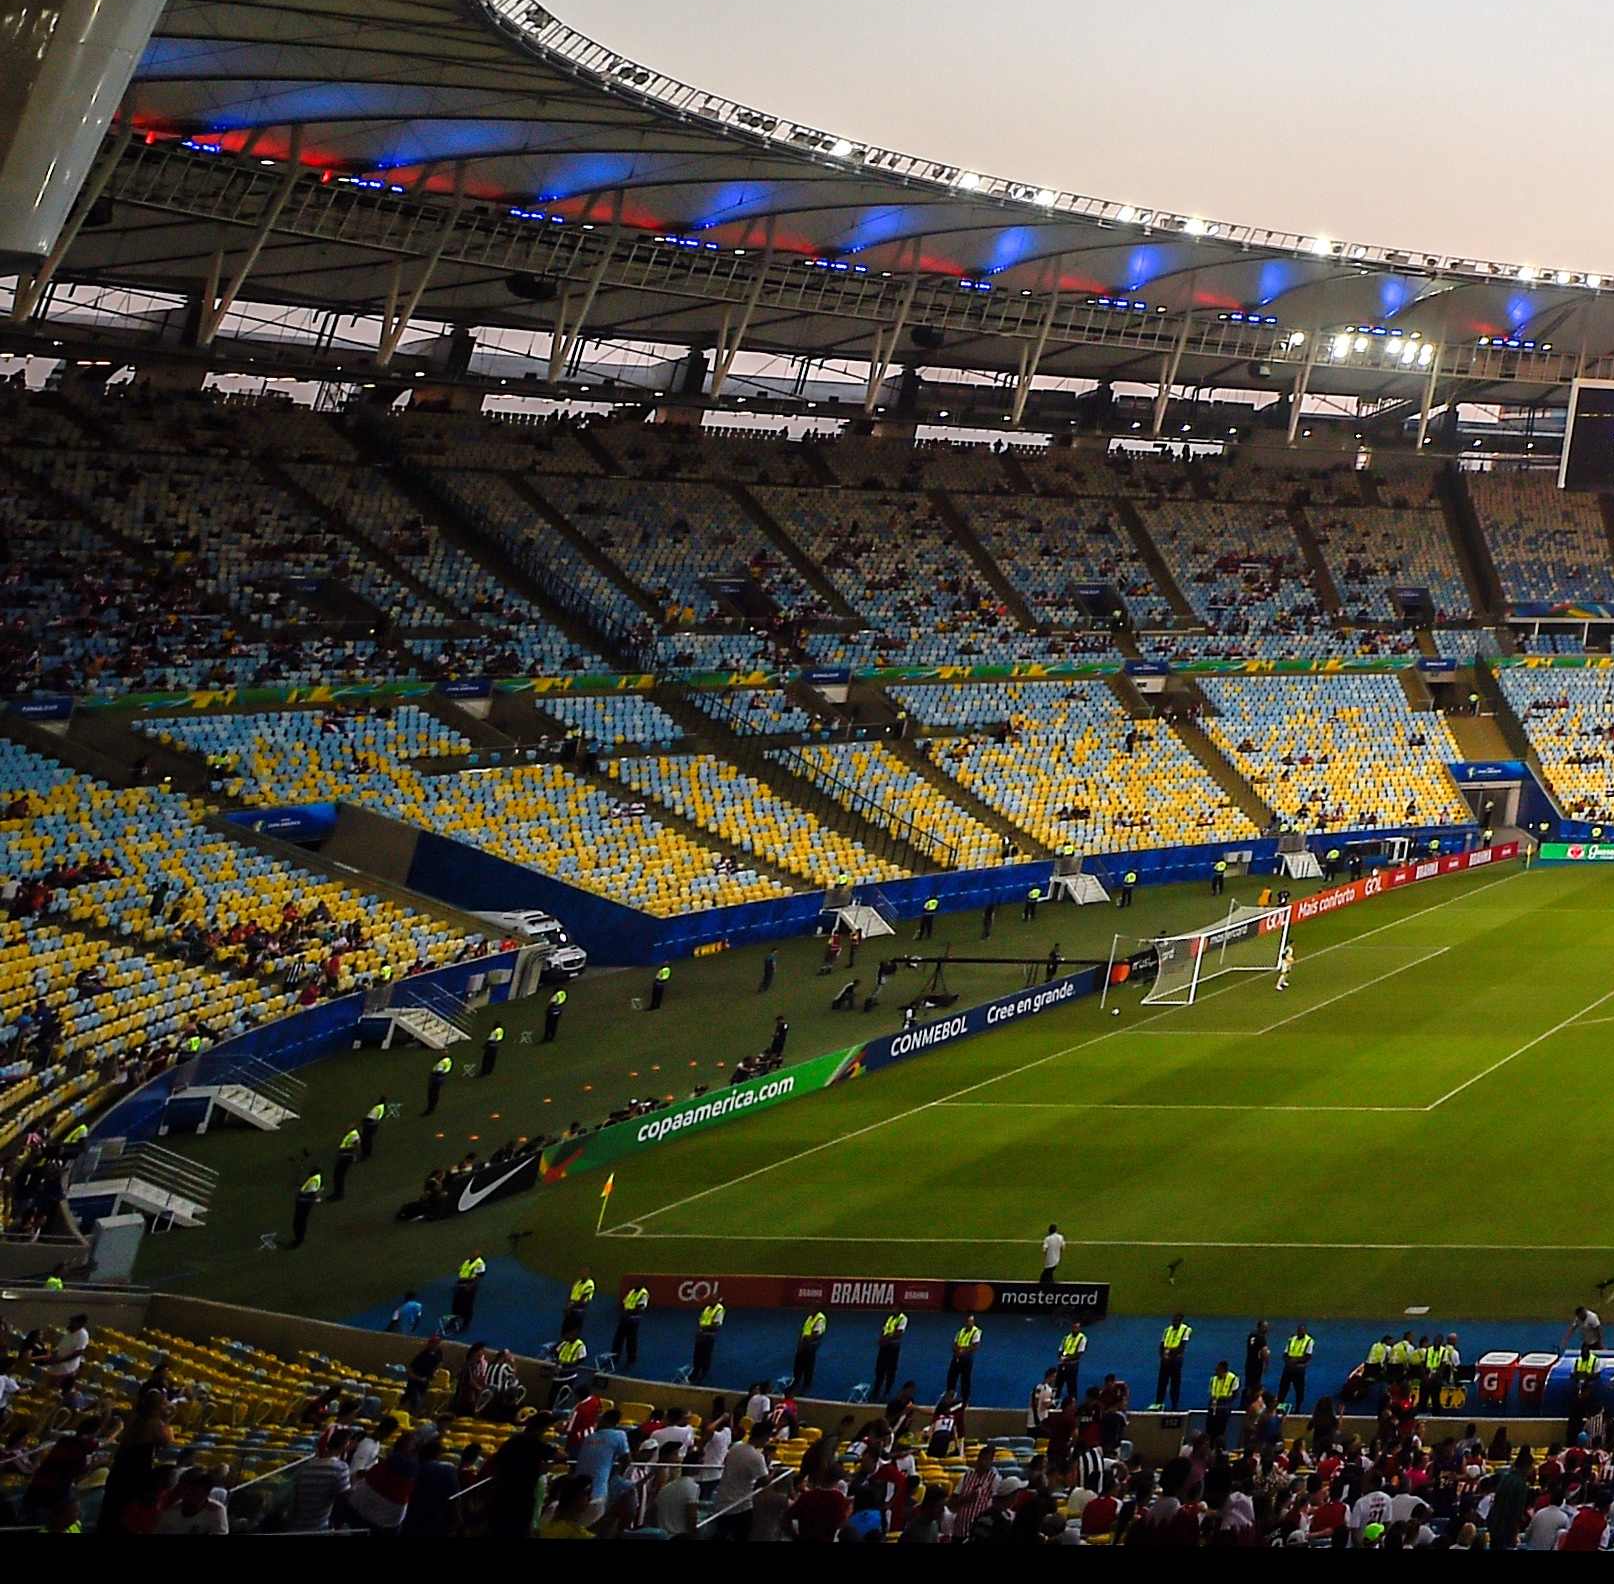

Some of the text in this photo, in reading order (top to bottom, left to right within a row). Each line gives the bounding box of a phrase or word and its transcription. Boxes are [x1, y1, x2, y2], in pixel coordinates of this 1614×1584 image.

[1365, 872, 1383, 896] GOL
[1298, 886, 1356, 919] Mais conforto
[987, 1003, 1015, 1025] Cree
[1017, 1000, 1031, 1016] en
[890, 1015, 968, 1057] CONMEBOL
[637, 1073, 794, 1143] copaamerica.com
[831, 1282, 895, 1305] BRAHMA
[1002, 1289, 1098, 1306] mastercard
[1483, 1372, 1498, 1391] G
[1522, 1374, 1537, 1392] G
